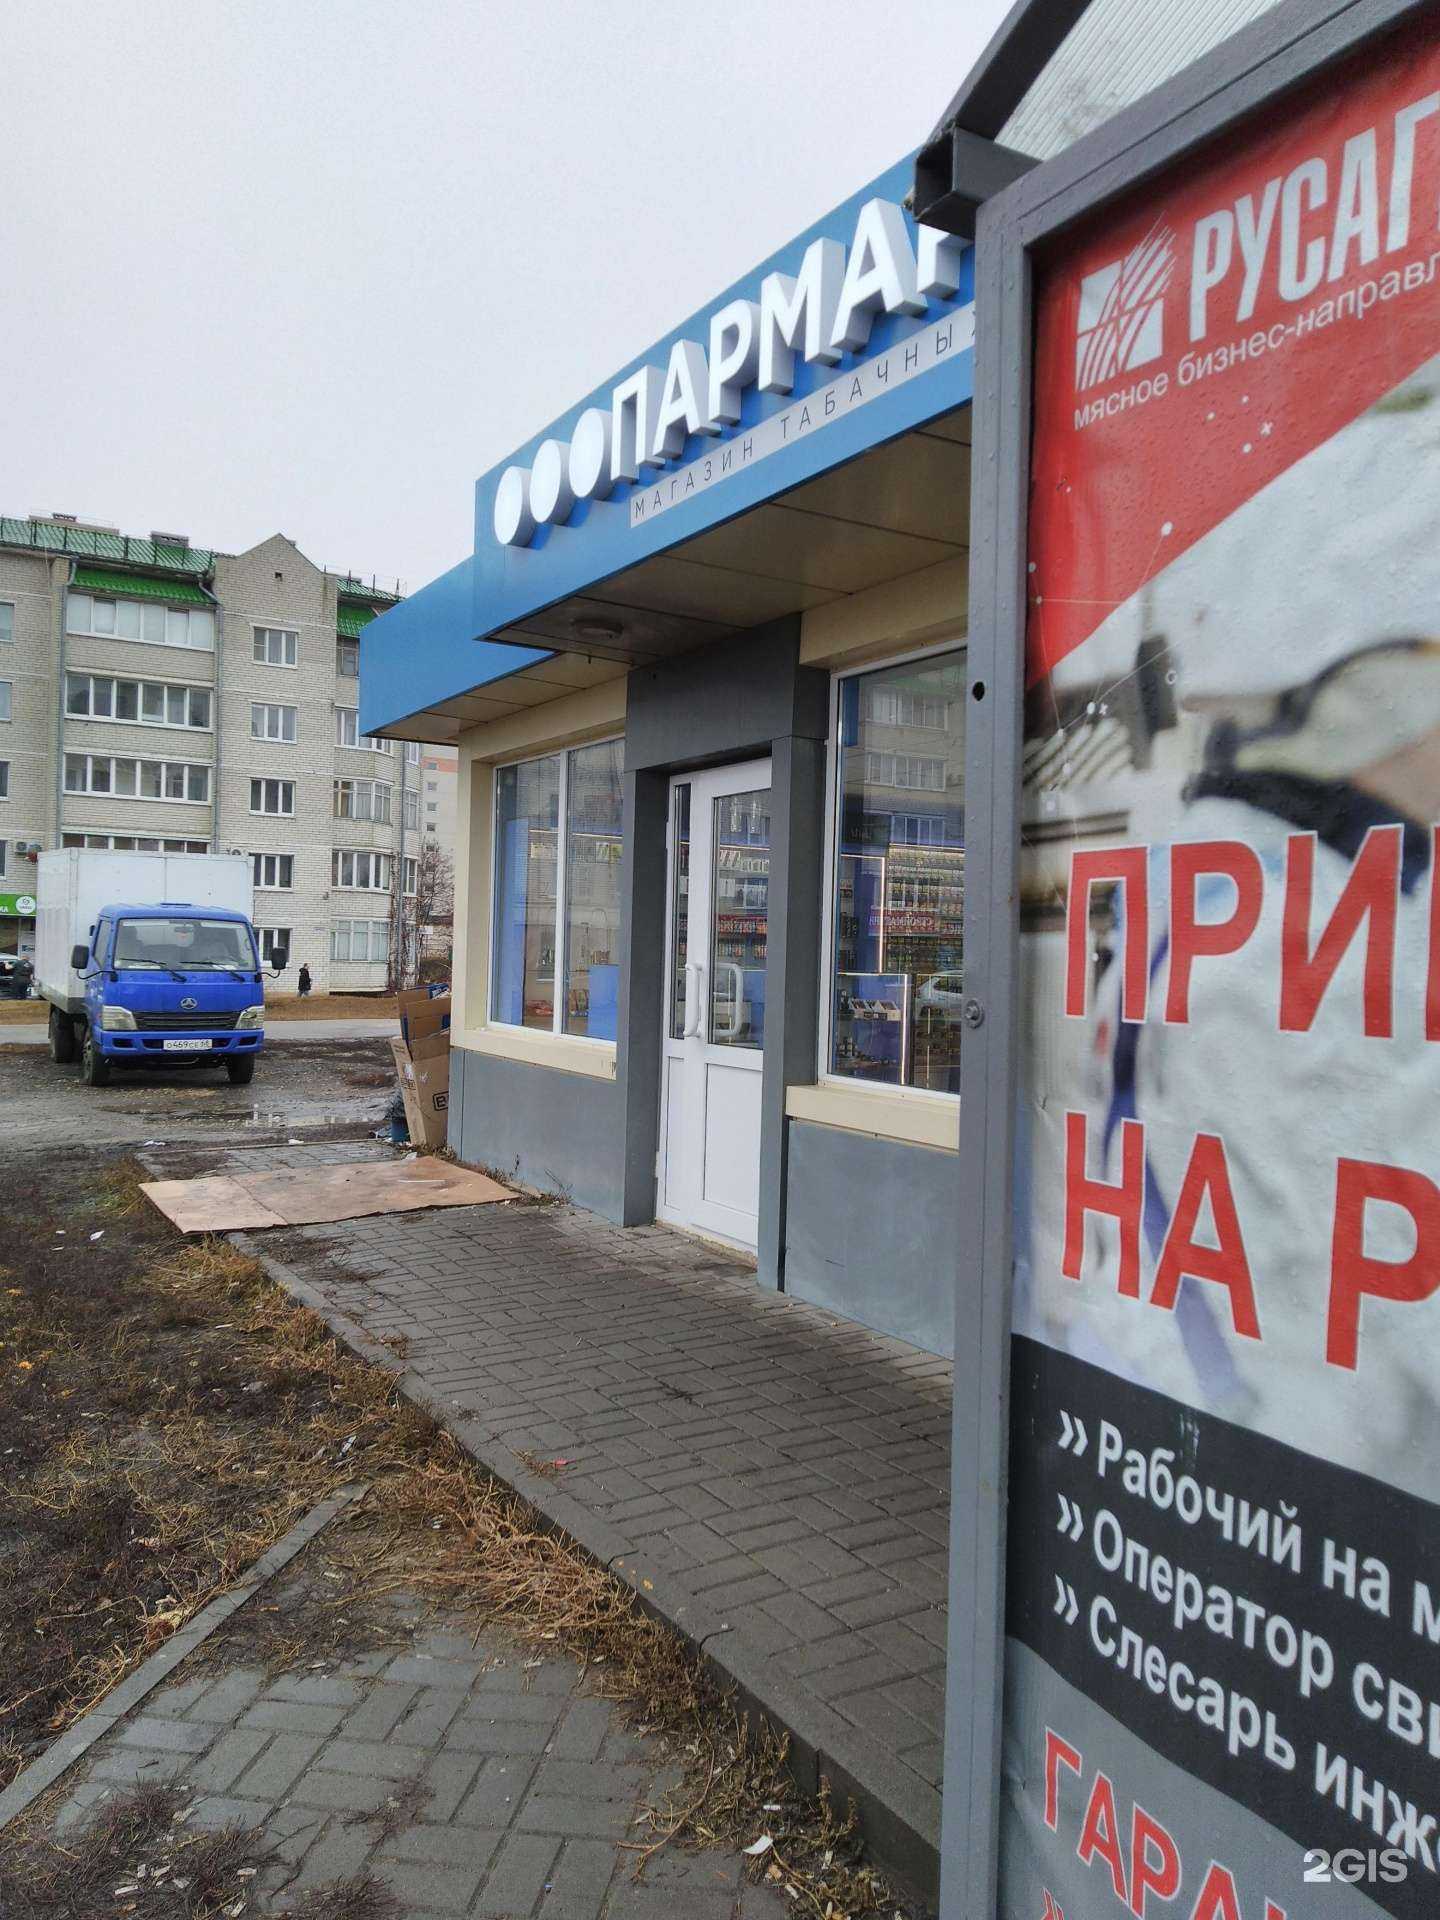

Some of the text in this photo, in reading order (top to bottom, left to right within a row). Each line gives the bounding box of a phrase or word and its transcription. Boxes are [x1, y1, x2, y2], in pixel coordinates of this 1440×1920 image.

[1189, 91, 1440, 343] РУСАГ
[635, 307, 975, 519] МАГАЗИН ТАБАЧНЫ
[1074, 371, 1169, 431] мясное
[1062, 1111, 1263, 1340] НА
[1093, 1508, 1335, 1699] Оператор
[1098, 1418, 1302, 1574] Рабочий
[1322, 1538, 1391, 1618] на
[1090, 1595, 1440, 1874] Слесарь инж
